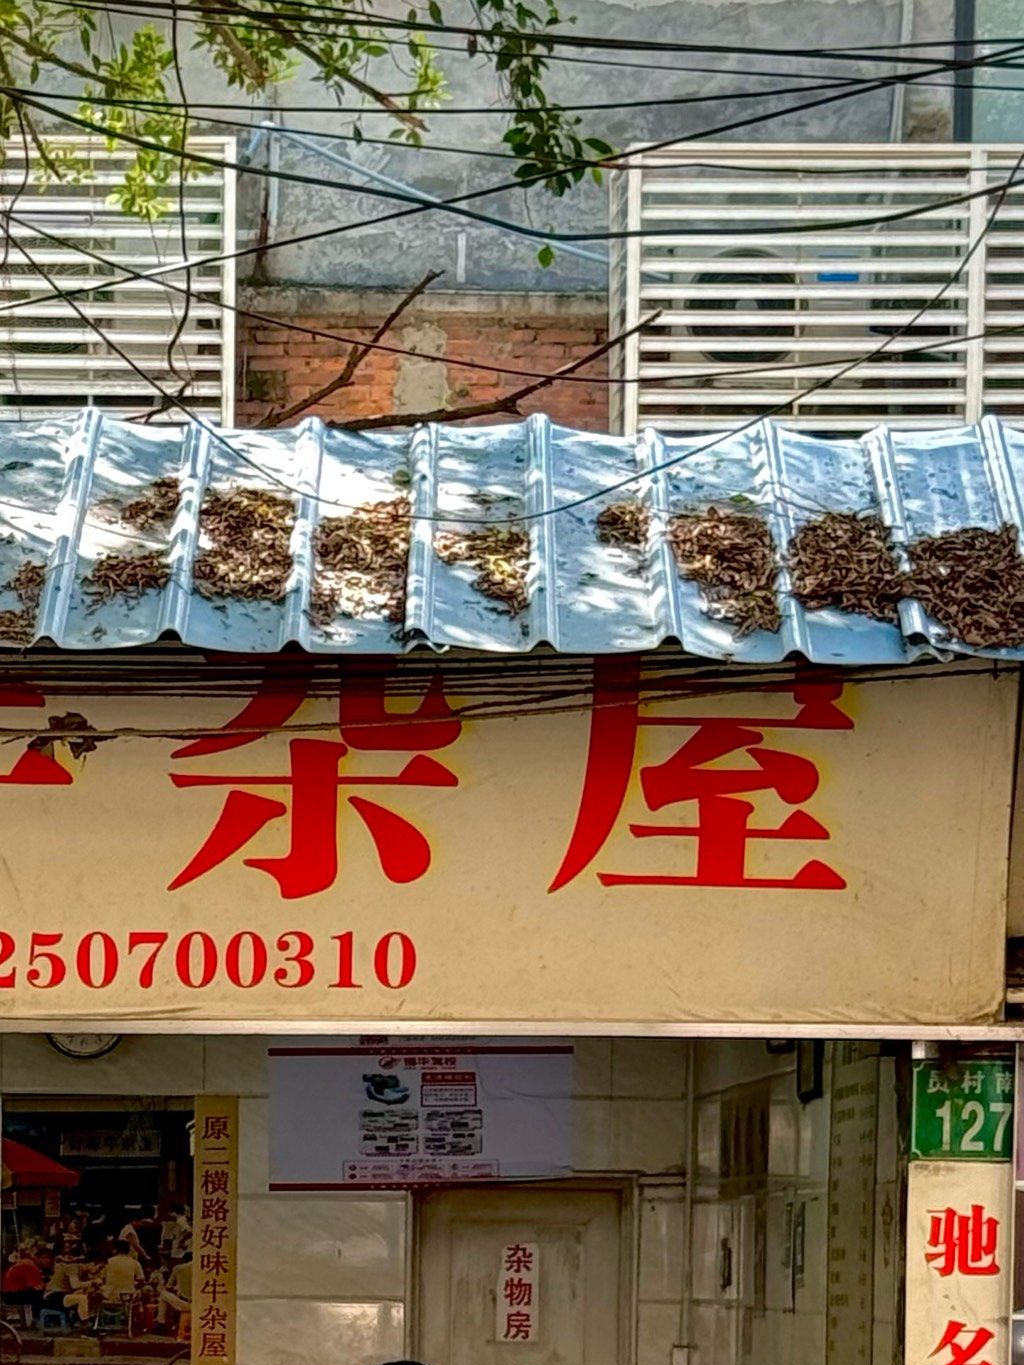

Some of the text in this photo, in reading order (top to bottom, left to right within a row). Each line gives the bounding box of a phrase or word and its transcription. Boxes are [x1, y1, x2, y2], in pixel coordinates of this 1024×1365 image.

[935, 1099, 1013, 1153] 127
[198, 1114, 231, 1359] 原二横路好味牛杂屋
[503, 1243, 533, 1341] 杂物房
